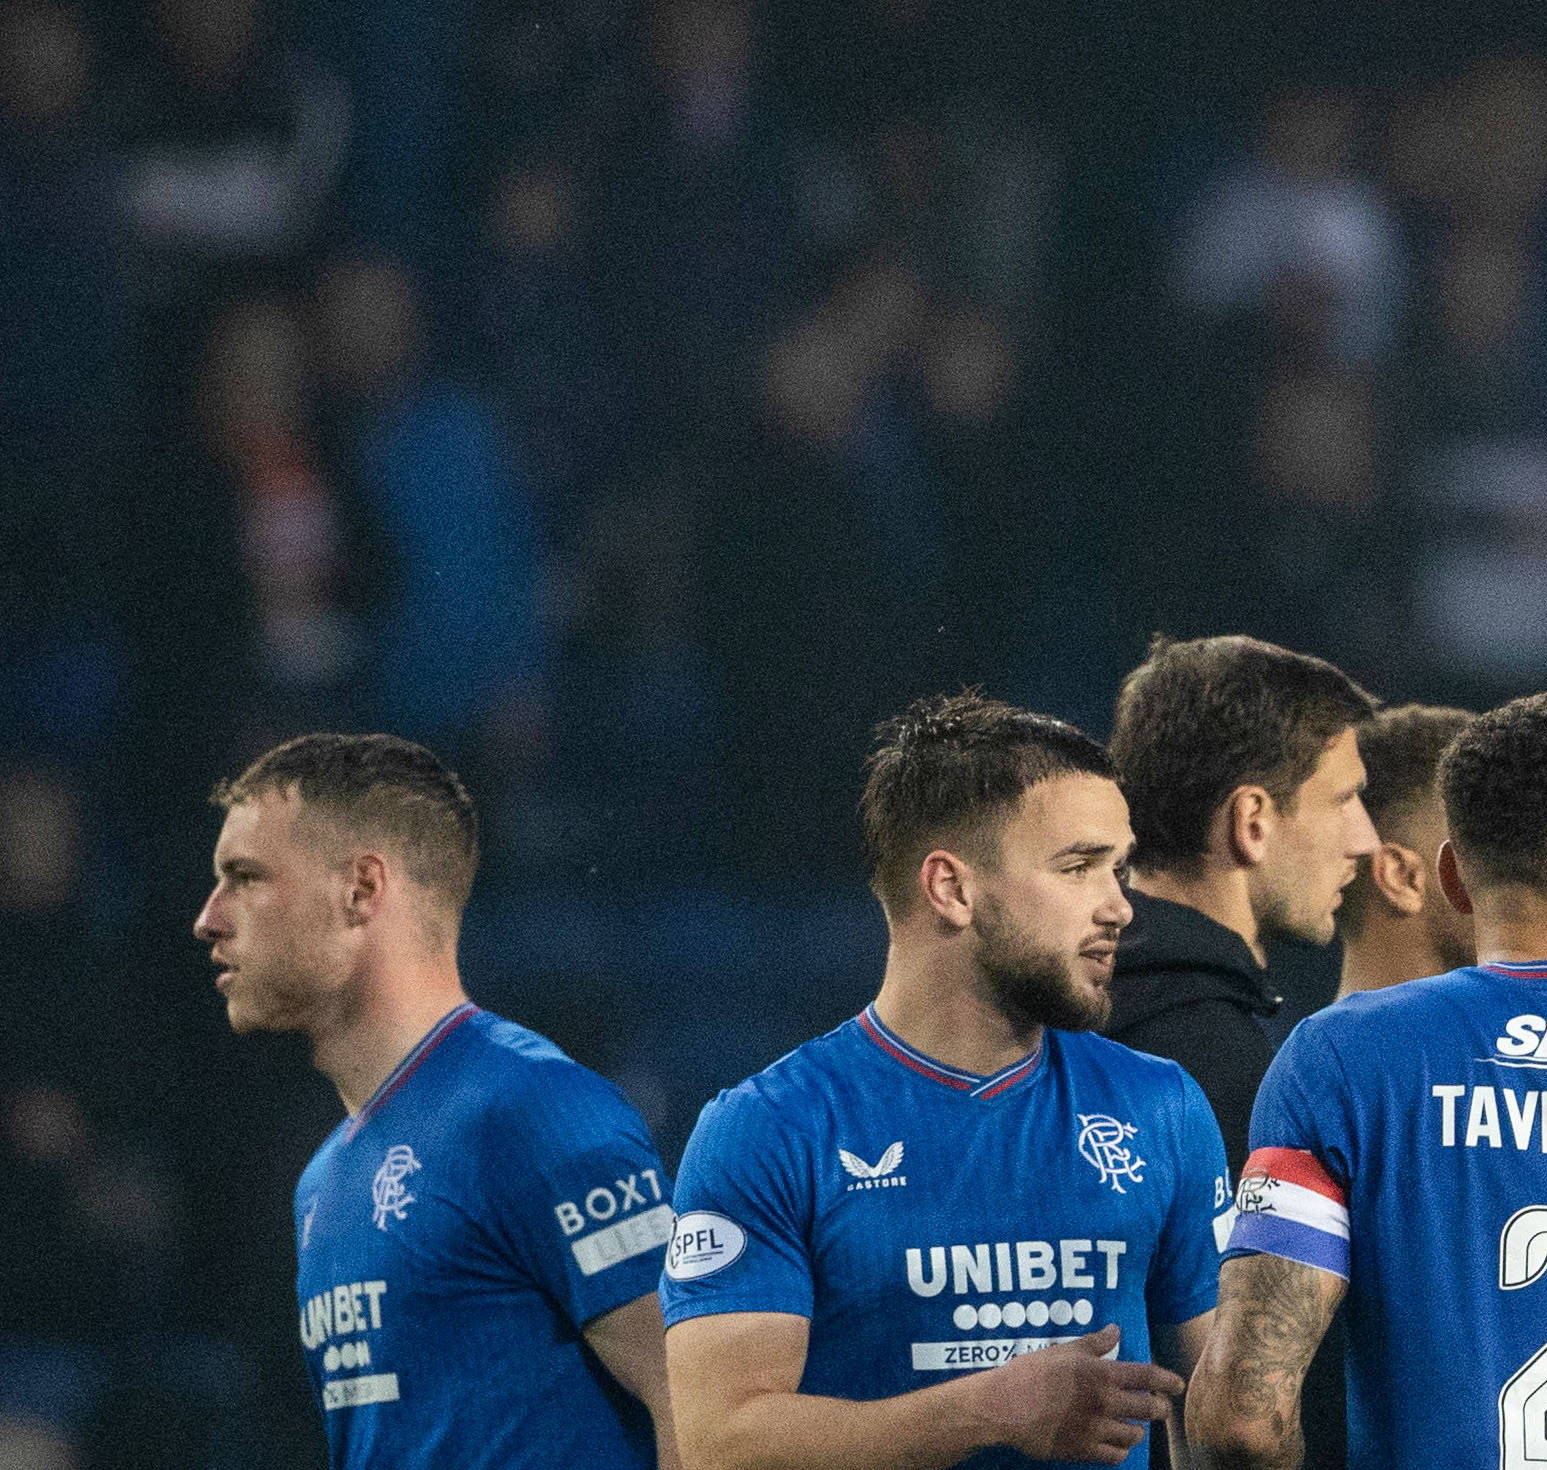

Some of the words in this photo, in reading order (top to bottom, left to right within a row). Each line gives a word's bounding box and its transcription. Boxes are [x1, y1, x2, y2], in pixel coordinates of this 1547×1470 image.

[847, 1176, 907, 1192] CASTORE
[674, 1228, 724, 1256] SPFL
[905, 1239, 1127, 1298] UNIBET
